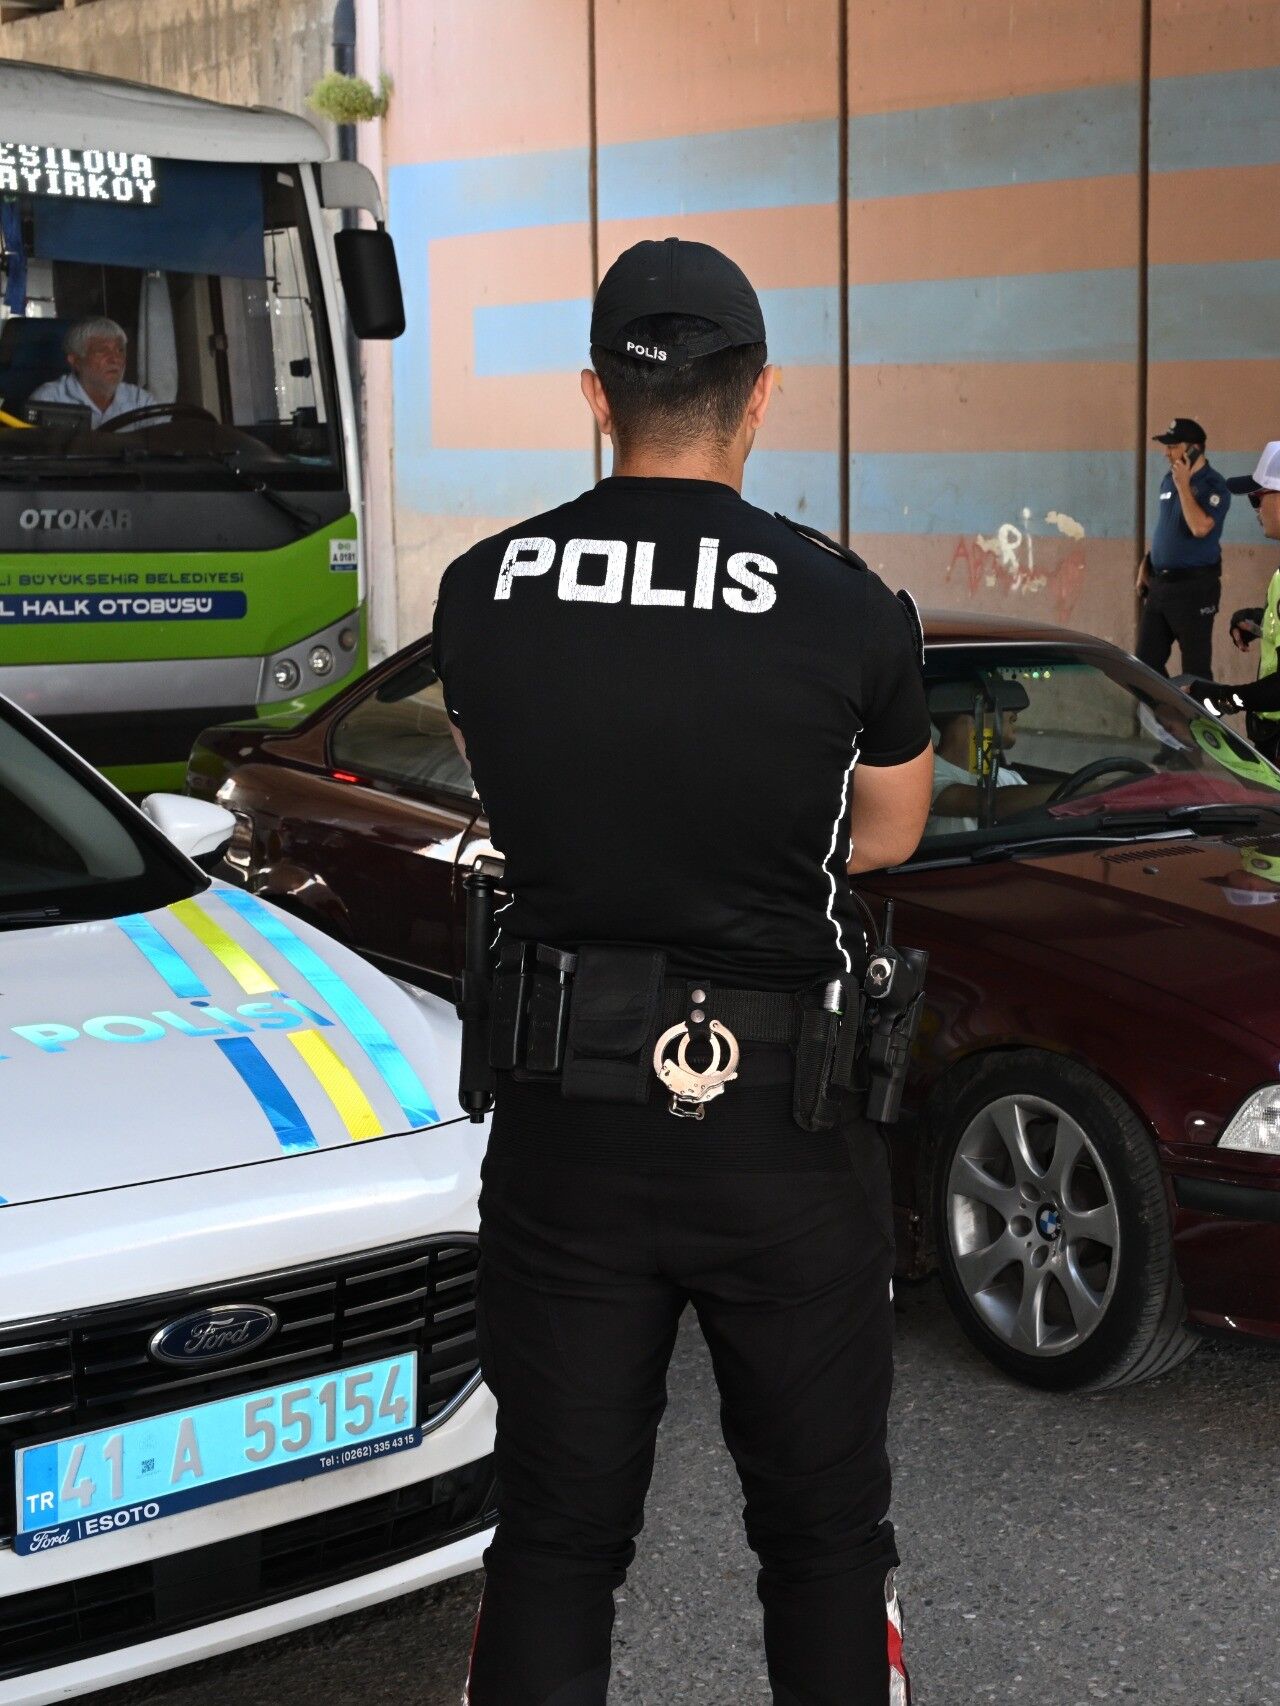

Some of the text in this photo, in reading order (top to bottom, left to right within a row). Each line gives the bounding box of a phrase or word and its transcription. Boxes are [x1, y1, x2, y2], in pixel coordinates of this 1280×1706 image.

[626, 341, 667, 361] POLİS
[19, 508, 133, 530] OTOKAR
[145, 572, 244, 585] BELEDİYESİ
[493, 535, 779, 614] POLİS
[22, 600, 91, 617] HALK
[98, 597, 212, 615] OTOBÜSÜ
[184, 1317, 251, 1354] Ford
[60, 1364, 409, 1508] 41 A 55154
[341, 1446, 372, 1465] (0262)
[374, 1442, 391, 1453] 335
[391, 1439, 403, 1448] 43
[404, 1434, 414, 1444] 15
[26, 1491, 55, 1514] TR
[29, 1502, 160, 1552] Ford ESOTO
